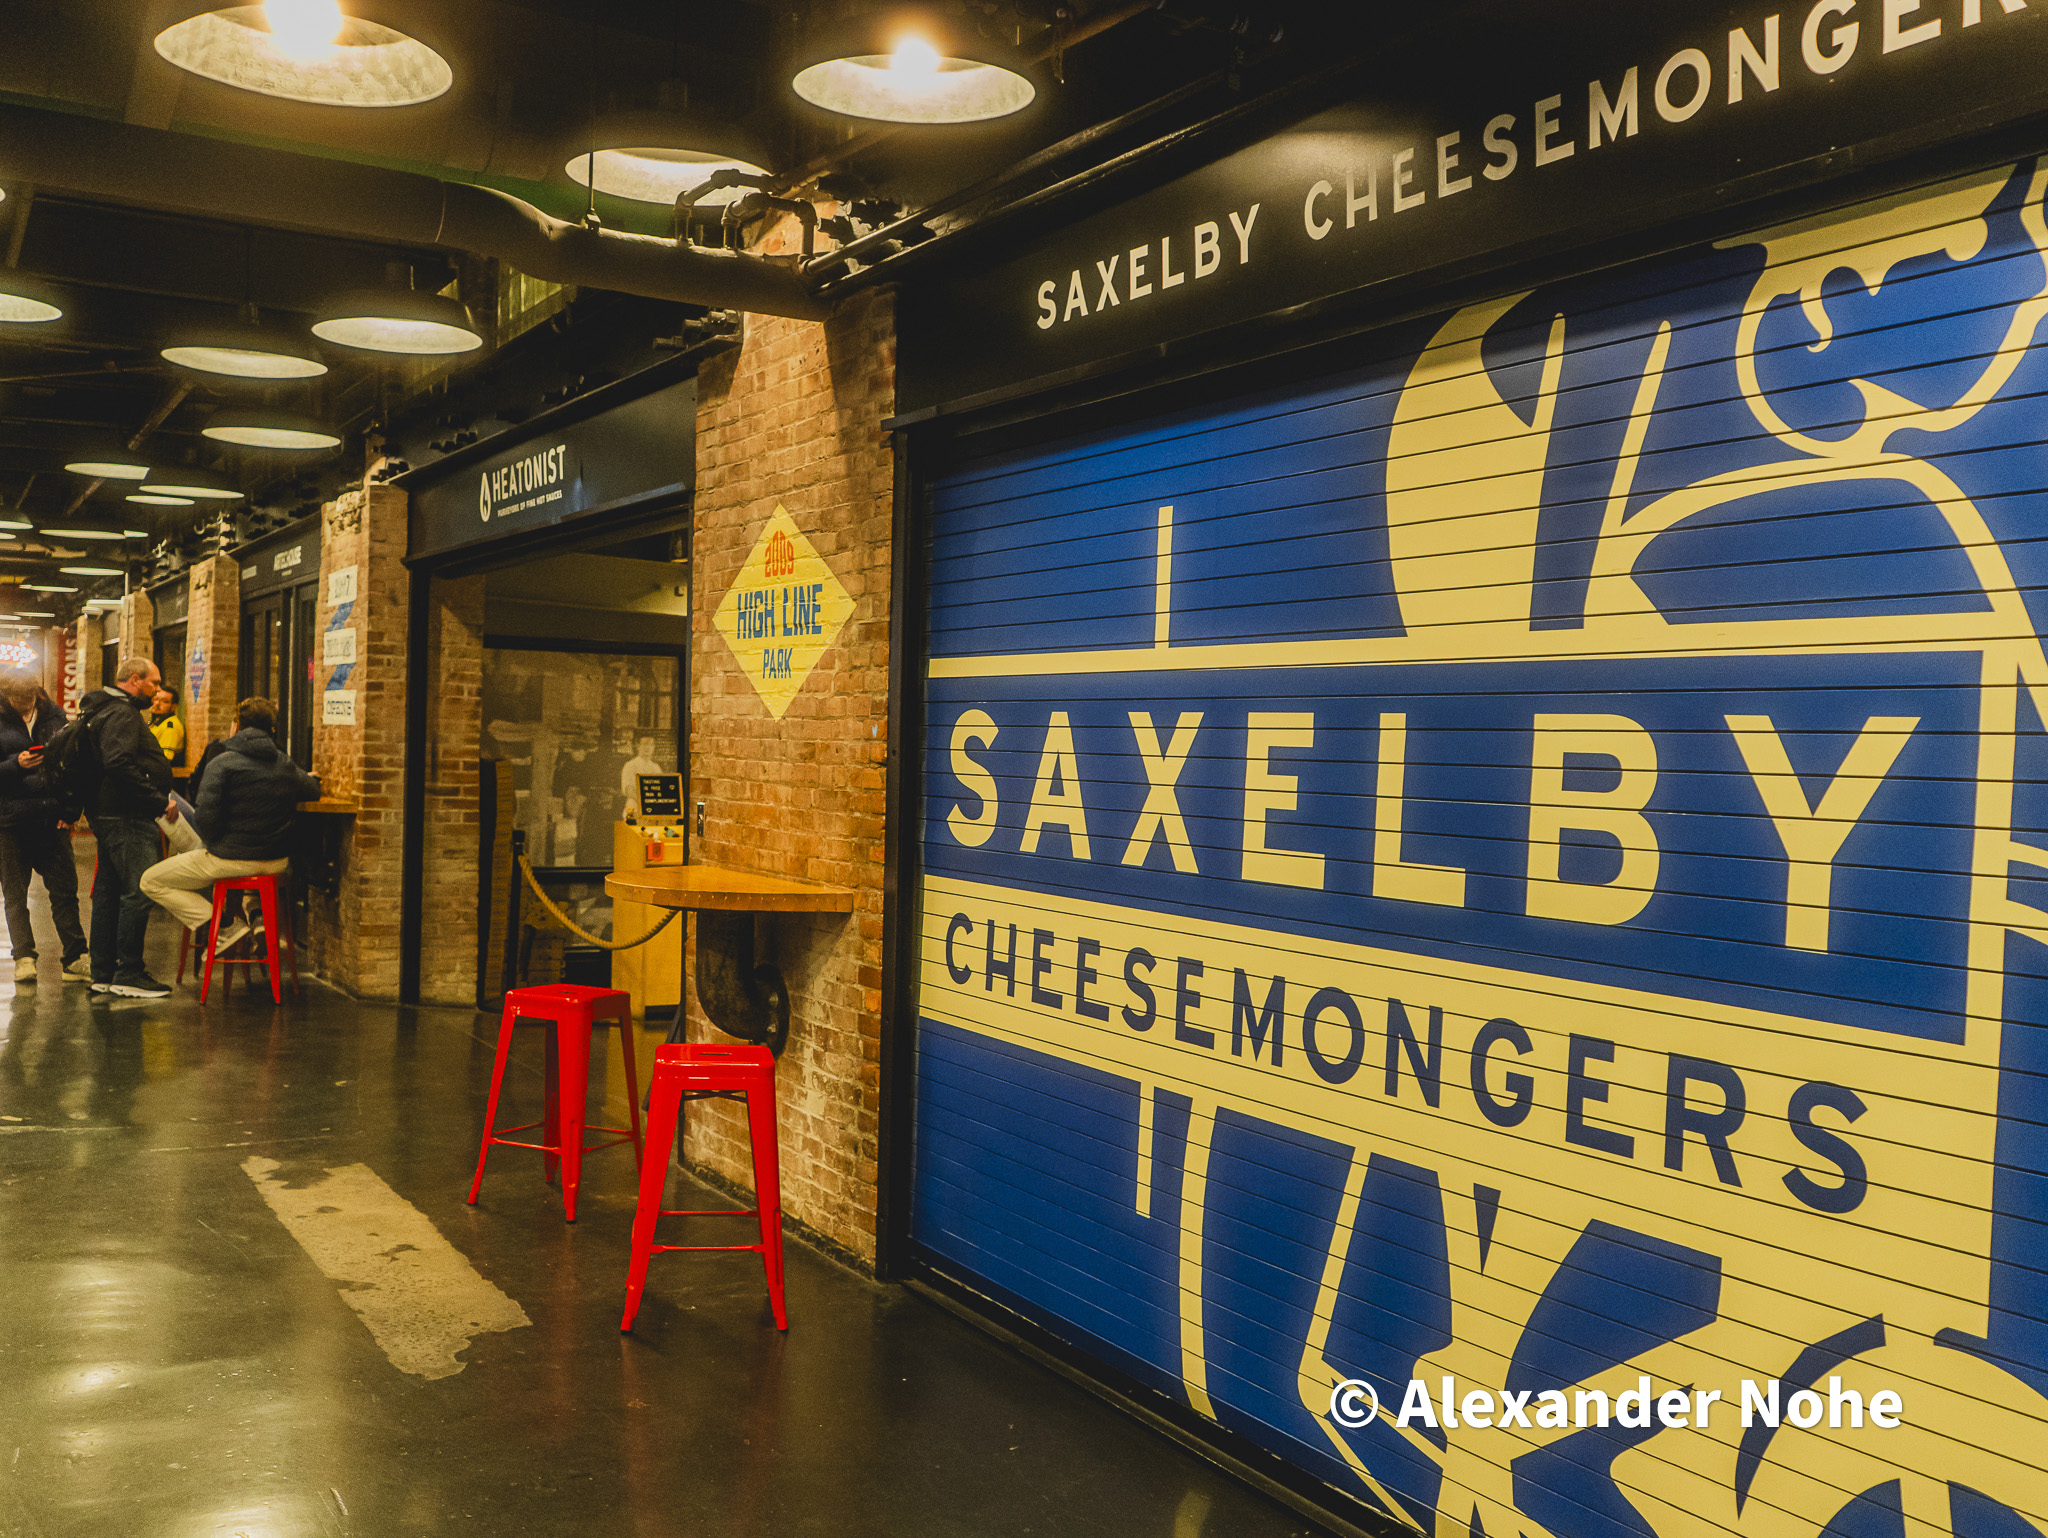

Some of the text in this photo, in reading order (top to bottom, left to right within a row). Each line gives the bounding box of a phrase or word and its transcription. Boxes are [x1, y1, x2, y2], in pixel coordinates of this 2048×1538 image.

[1036, 0, 2028, 331] SAXELBY CHEESEMONGE
[492, 444, 566, 503] HEATONIST
[764, 529, 795, 577] 2009
[736, 583, 823, 640] HIGH LINE
[762, 647, 793, 679] PARK
[945, 709, 1921, 956] SAXELBY
[944, 912, 1869, 1215] CHEESEMONGERS
